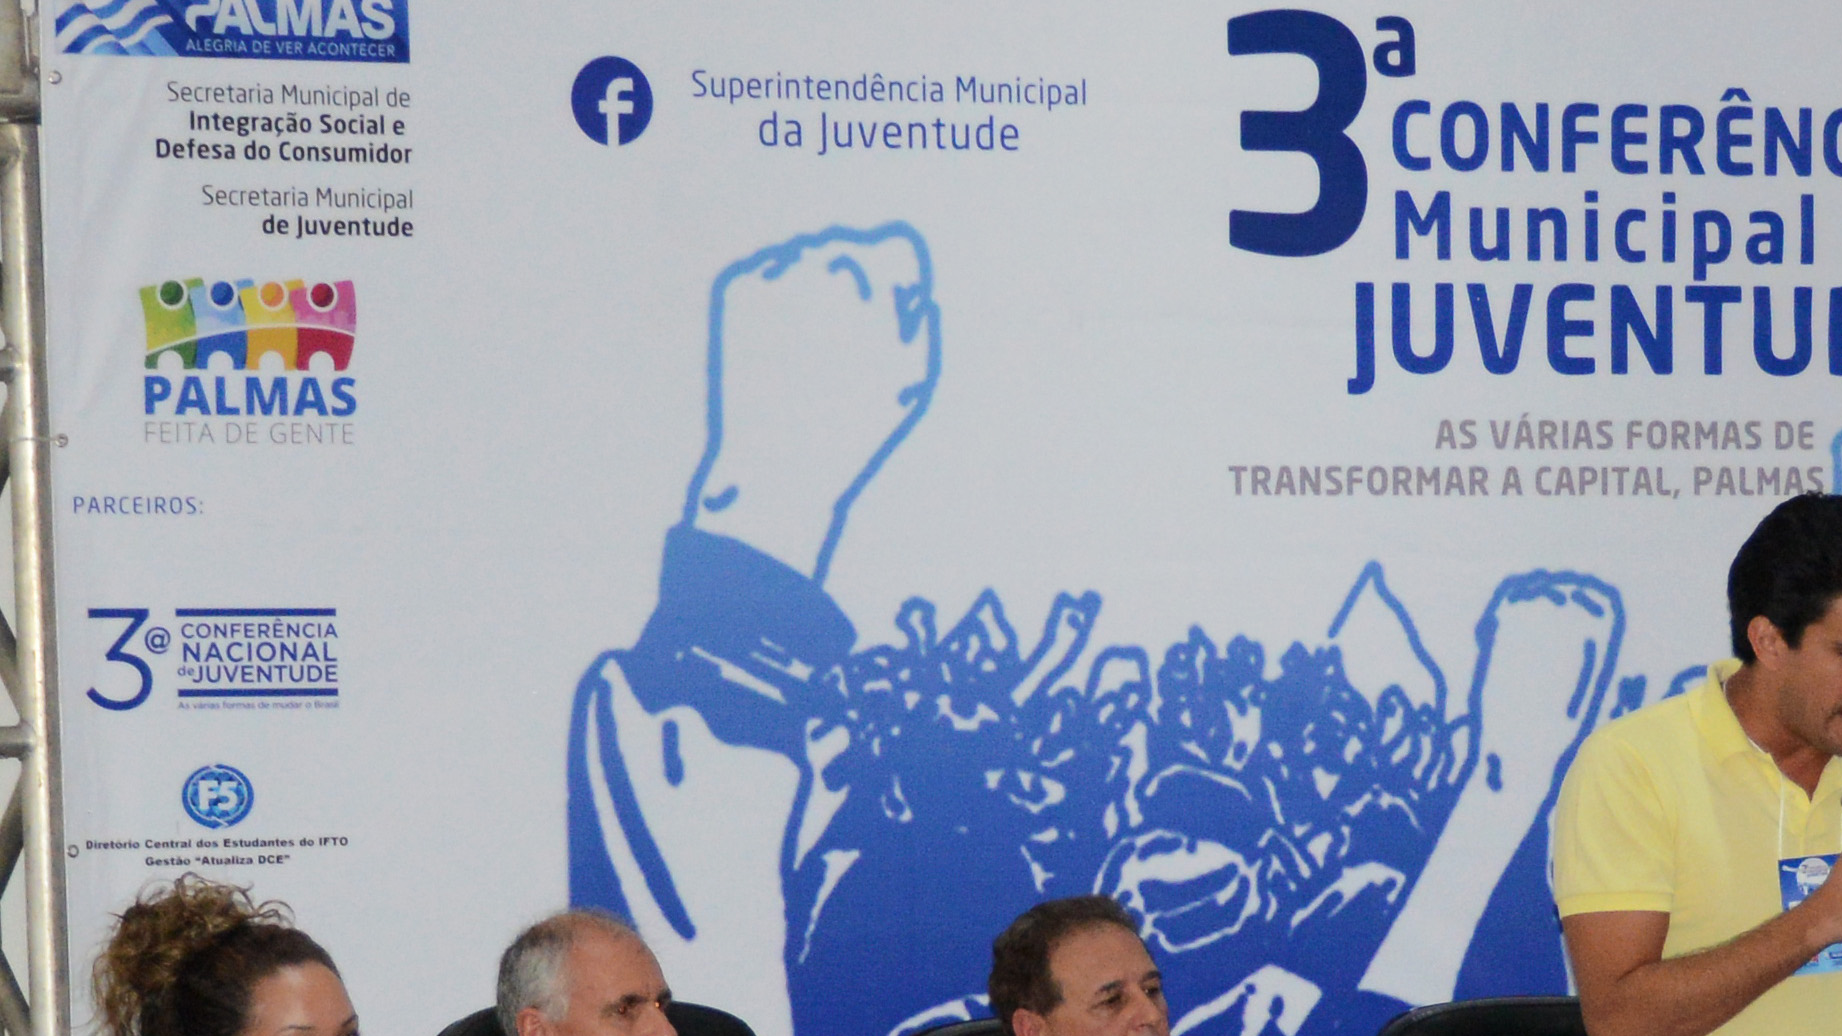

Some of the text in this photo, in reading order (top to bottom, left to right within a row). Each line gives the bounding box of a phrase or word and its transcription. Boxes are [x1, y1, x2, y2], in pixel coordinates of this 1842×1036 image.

[185, 38, 397, 58] ALEGRIA DE VER ACONTECER
[167, 80, 411, 112] Secretaria Municipal de
[691, 69, 1088, 112] Superintendência Municipal
[189, 110, 405, 138] Integração Social e
[758, 110, 1021, 157] da Juventude
[155, 138, 413, 164] Defesa do Consumidor
[201, 184, 413, 214] Secretaria Municipal
[262, 213, 414, 240] de Juventude
[1392, 189, 1815, 282] Municipal
[144, 375, 358, 417] PALMAS
[144, 420, 354, 445] FEITA DE GENTE
[1434, 412, 1814, 451] AS VÁRIAS FORMAS DE
[1228, 465, 1825, 500] TRANSFORMAR A CAPITAL, PALMAS
[72, 495, 203, 515] PARCEIROS:
[180, 618, 339, 640] CONFERÊNCIA
[182, 641, 338, 663] NACIONAL
[177, 664, 339, 684] de JUVENTUDE
[198, 779, 239, 811] F5
[85, 836, 349, 850] Diretório Central dos Estudantes do IFTO
[145, 856, 191, 867] Gestão
